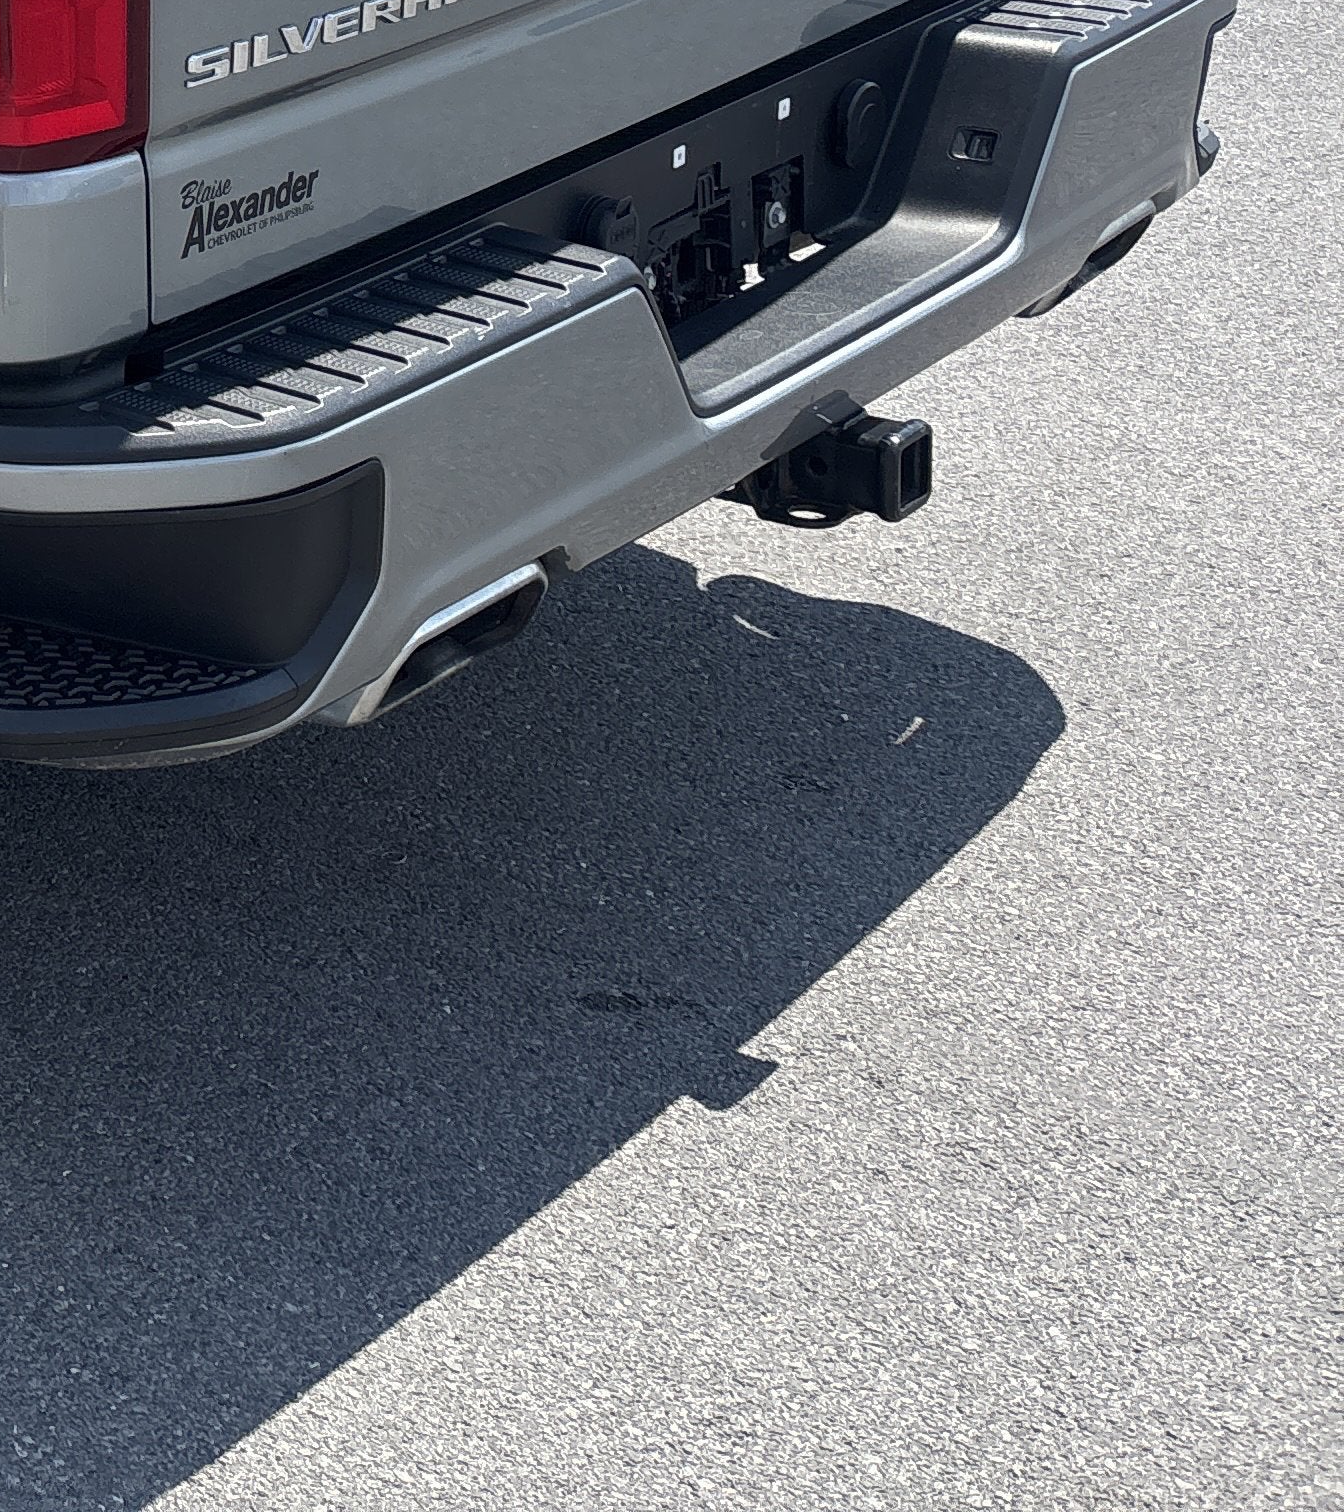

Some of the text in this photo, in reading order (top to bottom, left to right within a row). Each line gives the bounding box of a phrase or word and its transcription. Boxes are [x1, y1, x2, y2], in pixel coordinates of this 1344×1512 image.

[180, 178, 233, 210] Blaise
[180, 169, 320, 260] Alexander
[207, 221, 258, 250] CHEVROLET
[258, 218, 269, 231] OF
